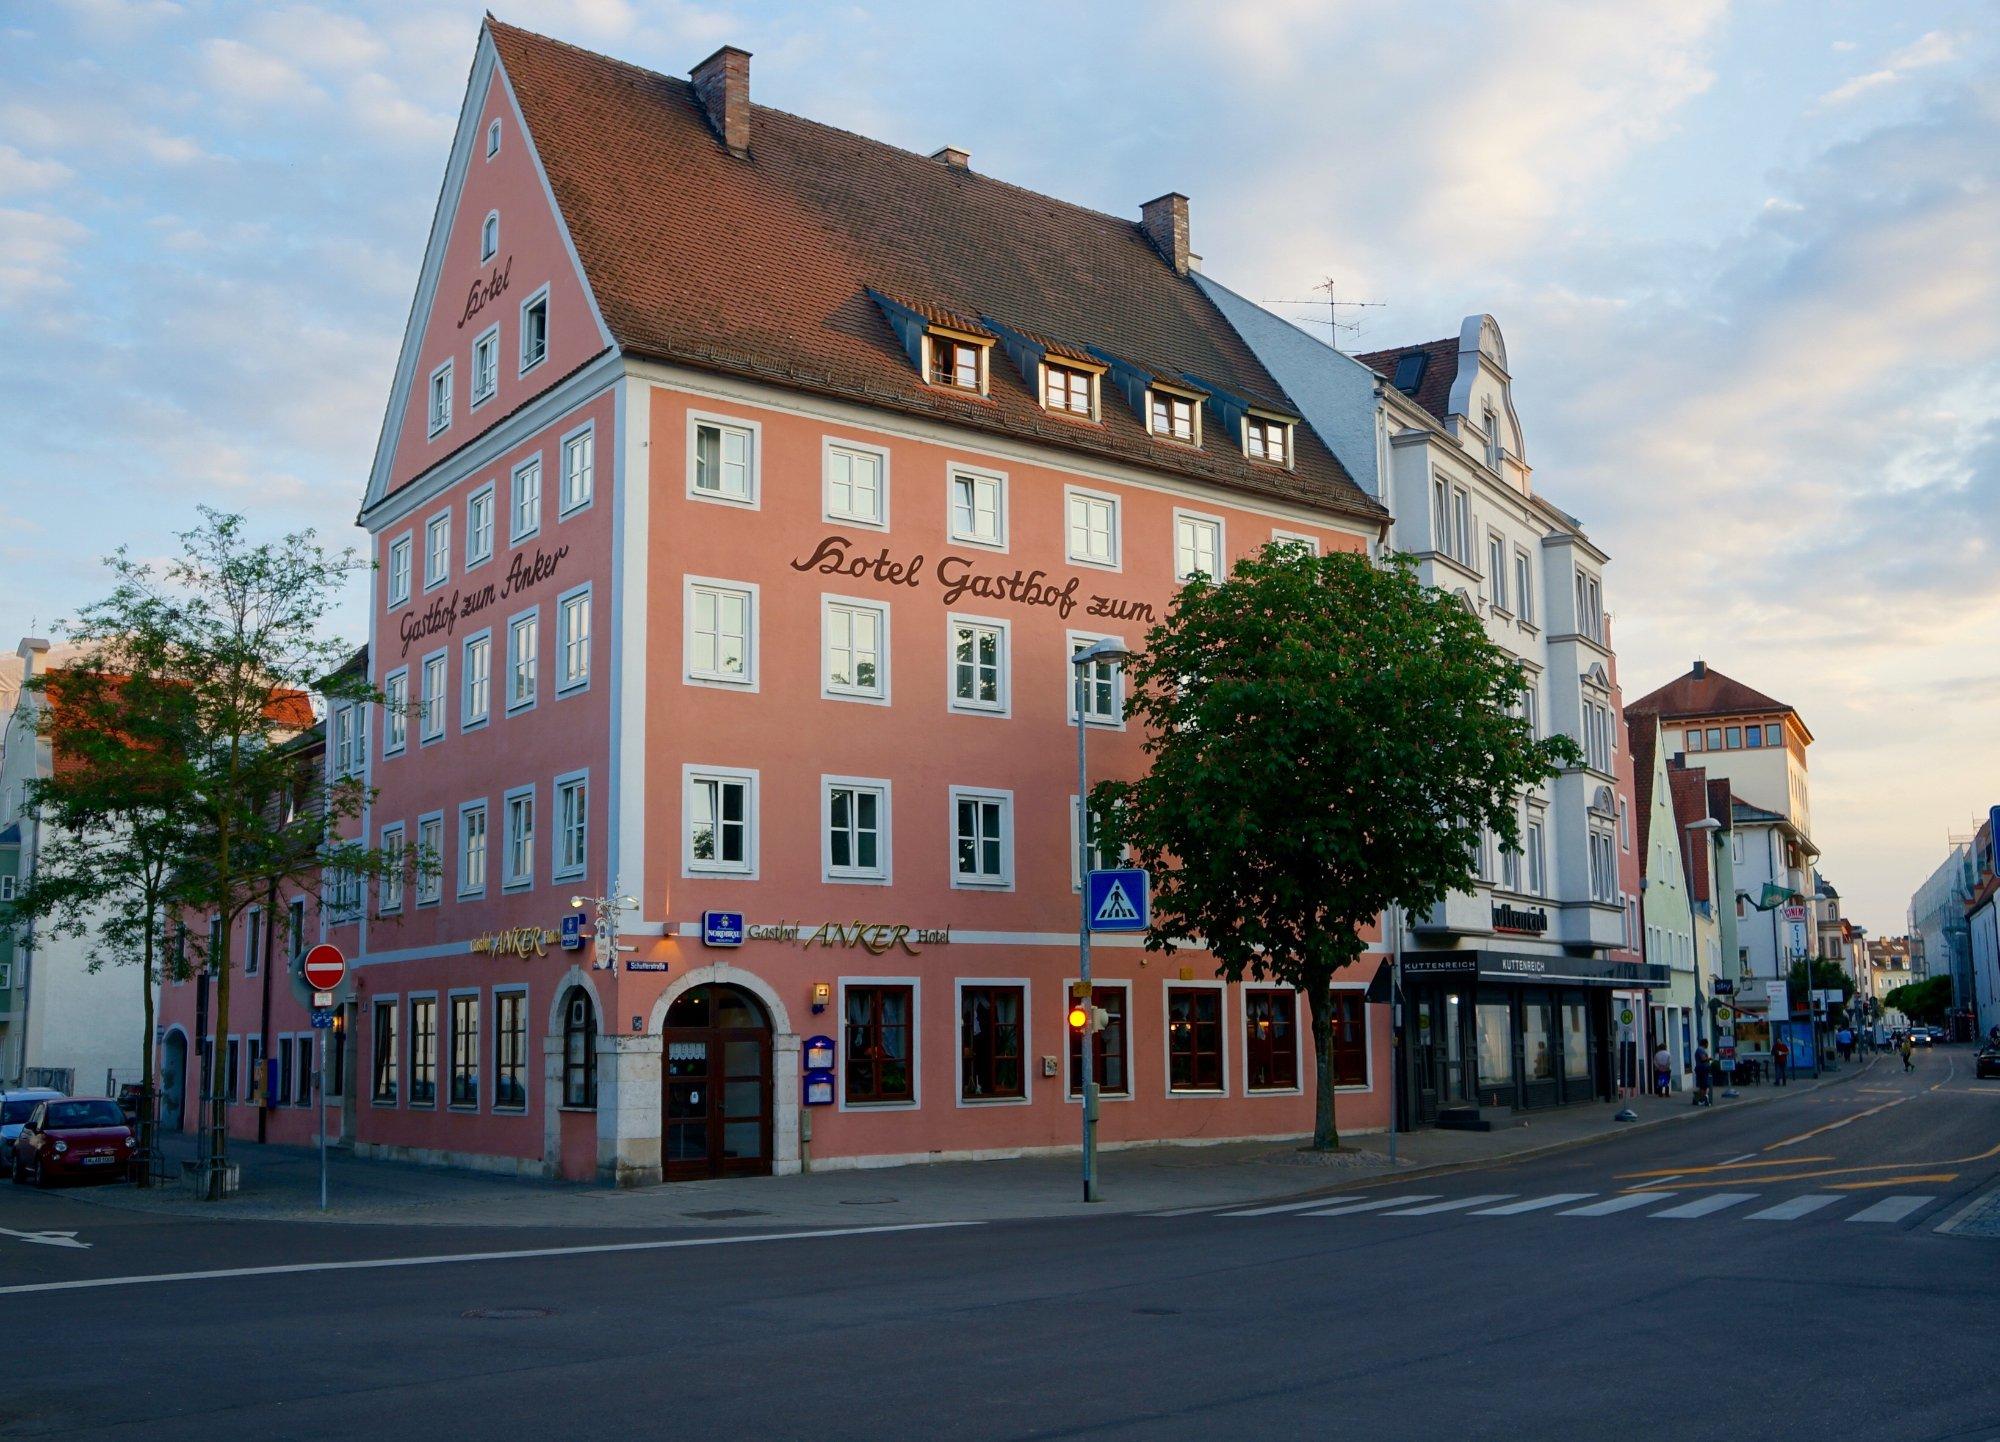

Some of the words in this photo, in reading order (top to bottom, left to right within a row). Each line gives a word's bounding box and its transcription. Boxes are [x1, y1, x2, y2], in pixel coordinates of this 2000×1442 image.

[457, 255, 512, 329] Hotel
[790, 535, 924, 587] Hotel
[937, 556, 1079, 619] Gasthof
[1086, 593, 1155, 624] zum
[400, 589, 459, 654] Gasthof
[461, 583, 496, 618] zum
[500, 545, 569, 599] Anker
[493, 926, 548, 959] ANKER
[747, 919, 800, 947] Gasthof
[803, 919, 922, 957] ANKER
[917, 923, 950, 944] Hotel
[1404, 960, 1476, 970] KUTTENREICH
[1502, 959, 1545, 972] KUTTENREICH
